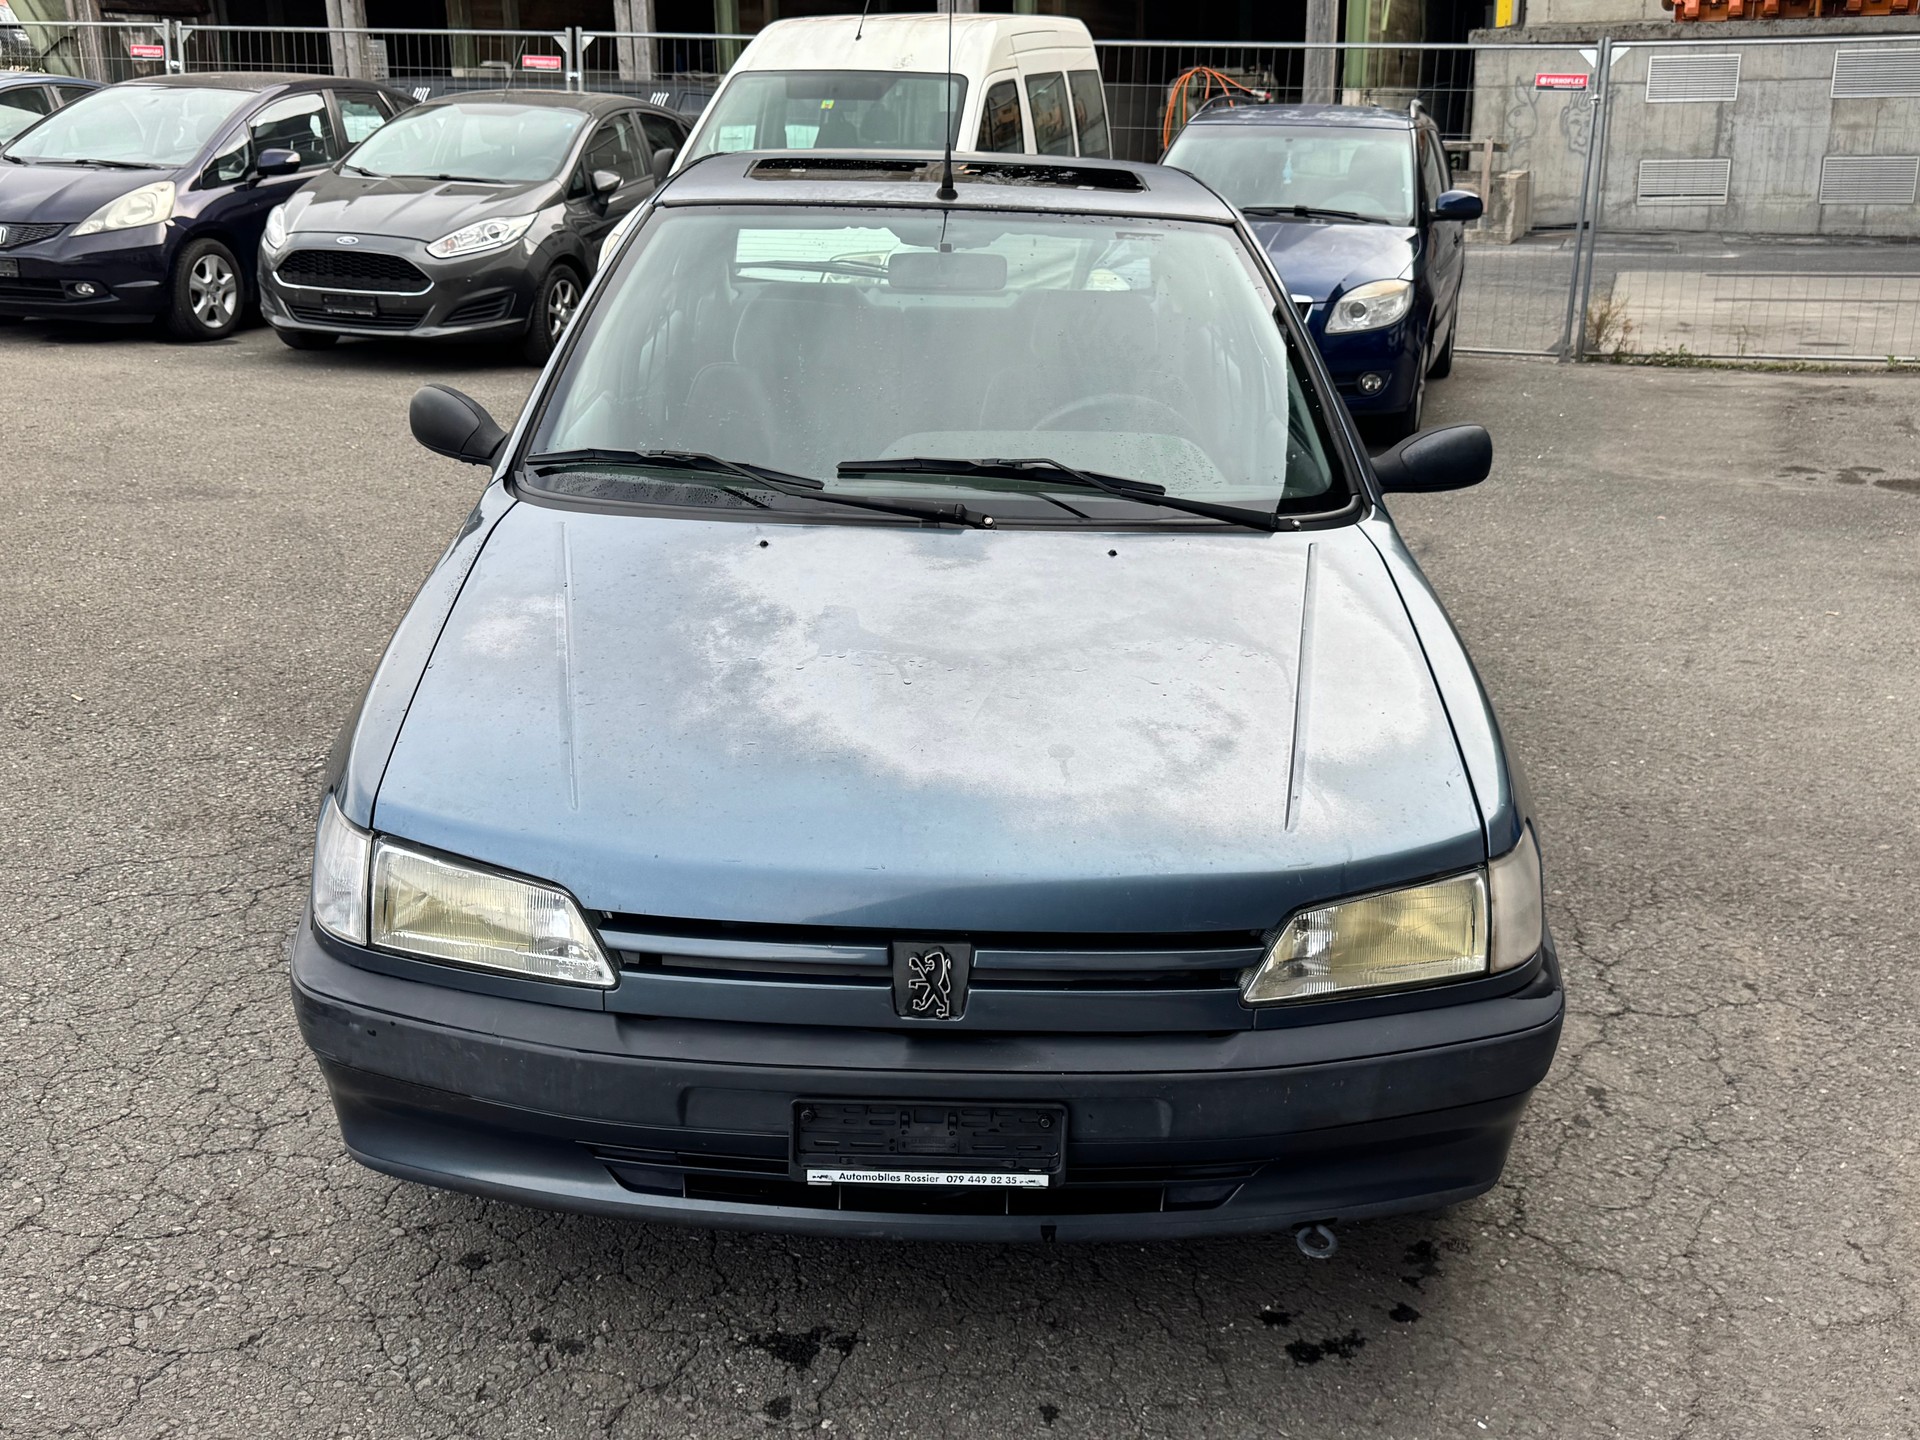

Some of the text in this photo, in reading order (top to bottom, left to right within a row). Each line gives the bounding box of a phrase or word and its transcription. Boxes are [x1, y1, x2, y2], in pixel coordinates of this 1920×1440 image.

[838, 1172, 1017, 1185] Automobiles Rossier 079 449 82 35
